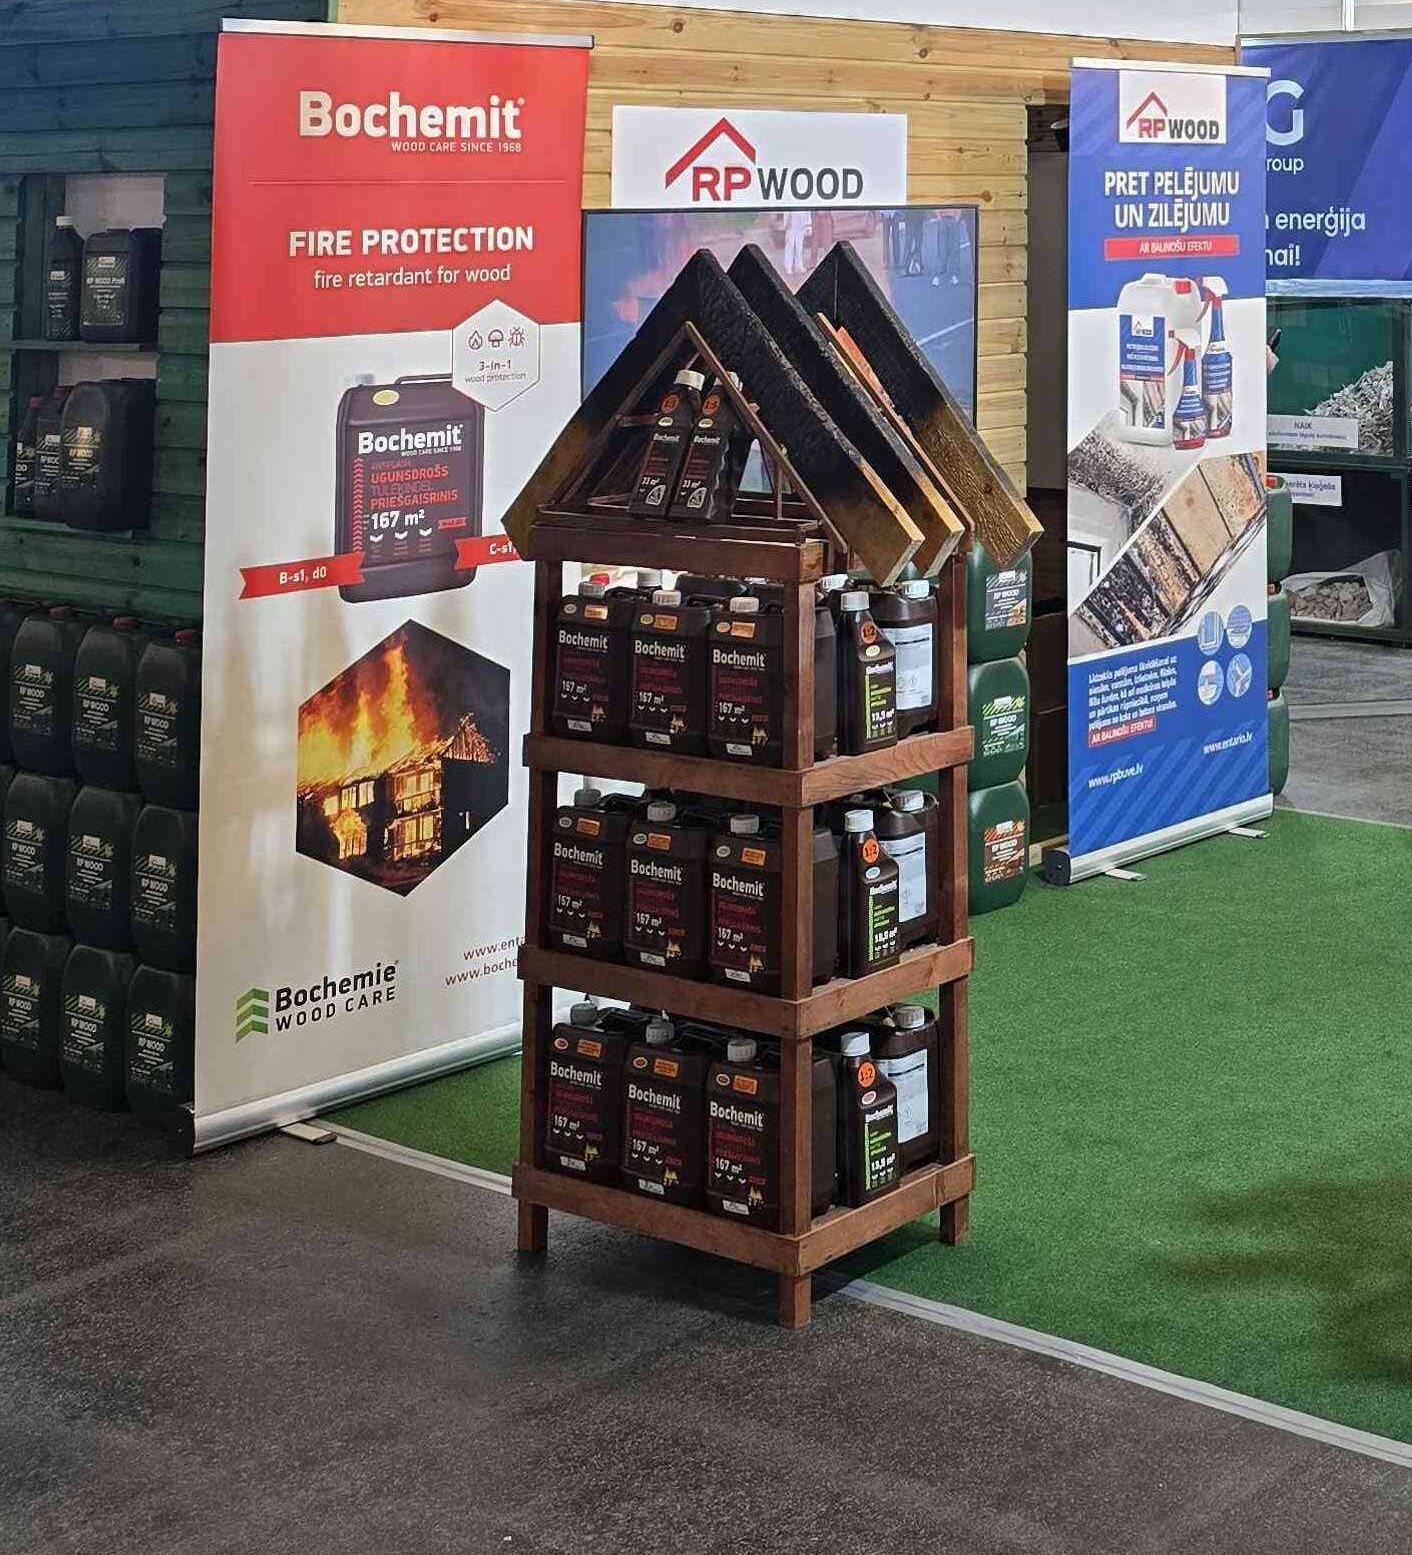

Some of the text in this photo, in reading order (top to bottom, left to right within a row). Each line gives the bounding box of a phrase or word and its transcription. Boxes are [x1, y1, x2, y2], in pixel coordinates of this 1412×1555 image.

[391, 141, 522, 154] WOOD CARE SINCE 1968
[1266, 157, 1305, 175] roup
[1104, 166, 1241, 202] PRET PELĒJUMU
[1114, 198, 1231, 234] UN ZILĒJUMU
[1275, 205, 1367, 238] enerģija
[288, 225, 535, 257] FIRE PROTECTION
[313, 264, 512, 289] fire retardant for wood
[479, 359, 512, 372] 3-in-1
[358, 424, 463, 455] Bochemit
[371, 510, 401, 531] 167
[558, 629, 609, 650] Bochemit
[634, 639, 686, 660] Bochemit
[712, 648, 766, 668] Bochemit
[718, 701, 733, 714] 167
[553, 842, 604, 866] Bochemit
[630, 859, 683, 882] Bochemit
[712, 872, 765, 897] Bochemit
[275, 961, 397, 1013] Bochemie
[276, 985, 397, 1033] WOOD CARE
[550, 1060, 602, 1086] Bochemit
[628, 1083, 681, 1109] Bochemit
[709, 1100, 764, 1128] Bochemit
[715, 1157, 730, 1171] 167
